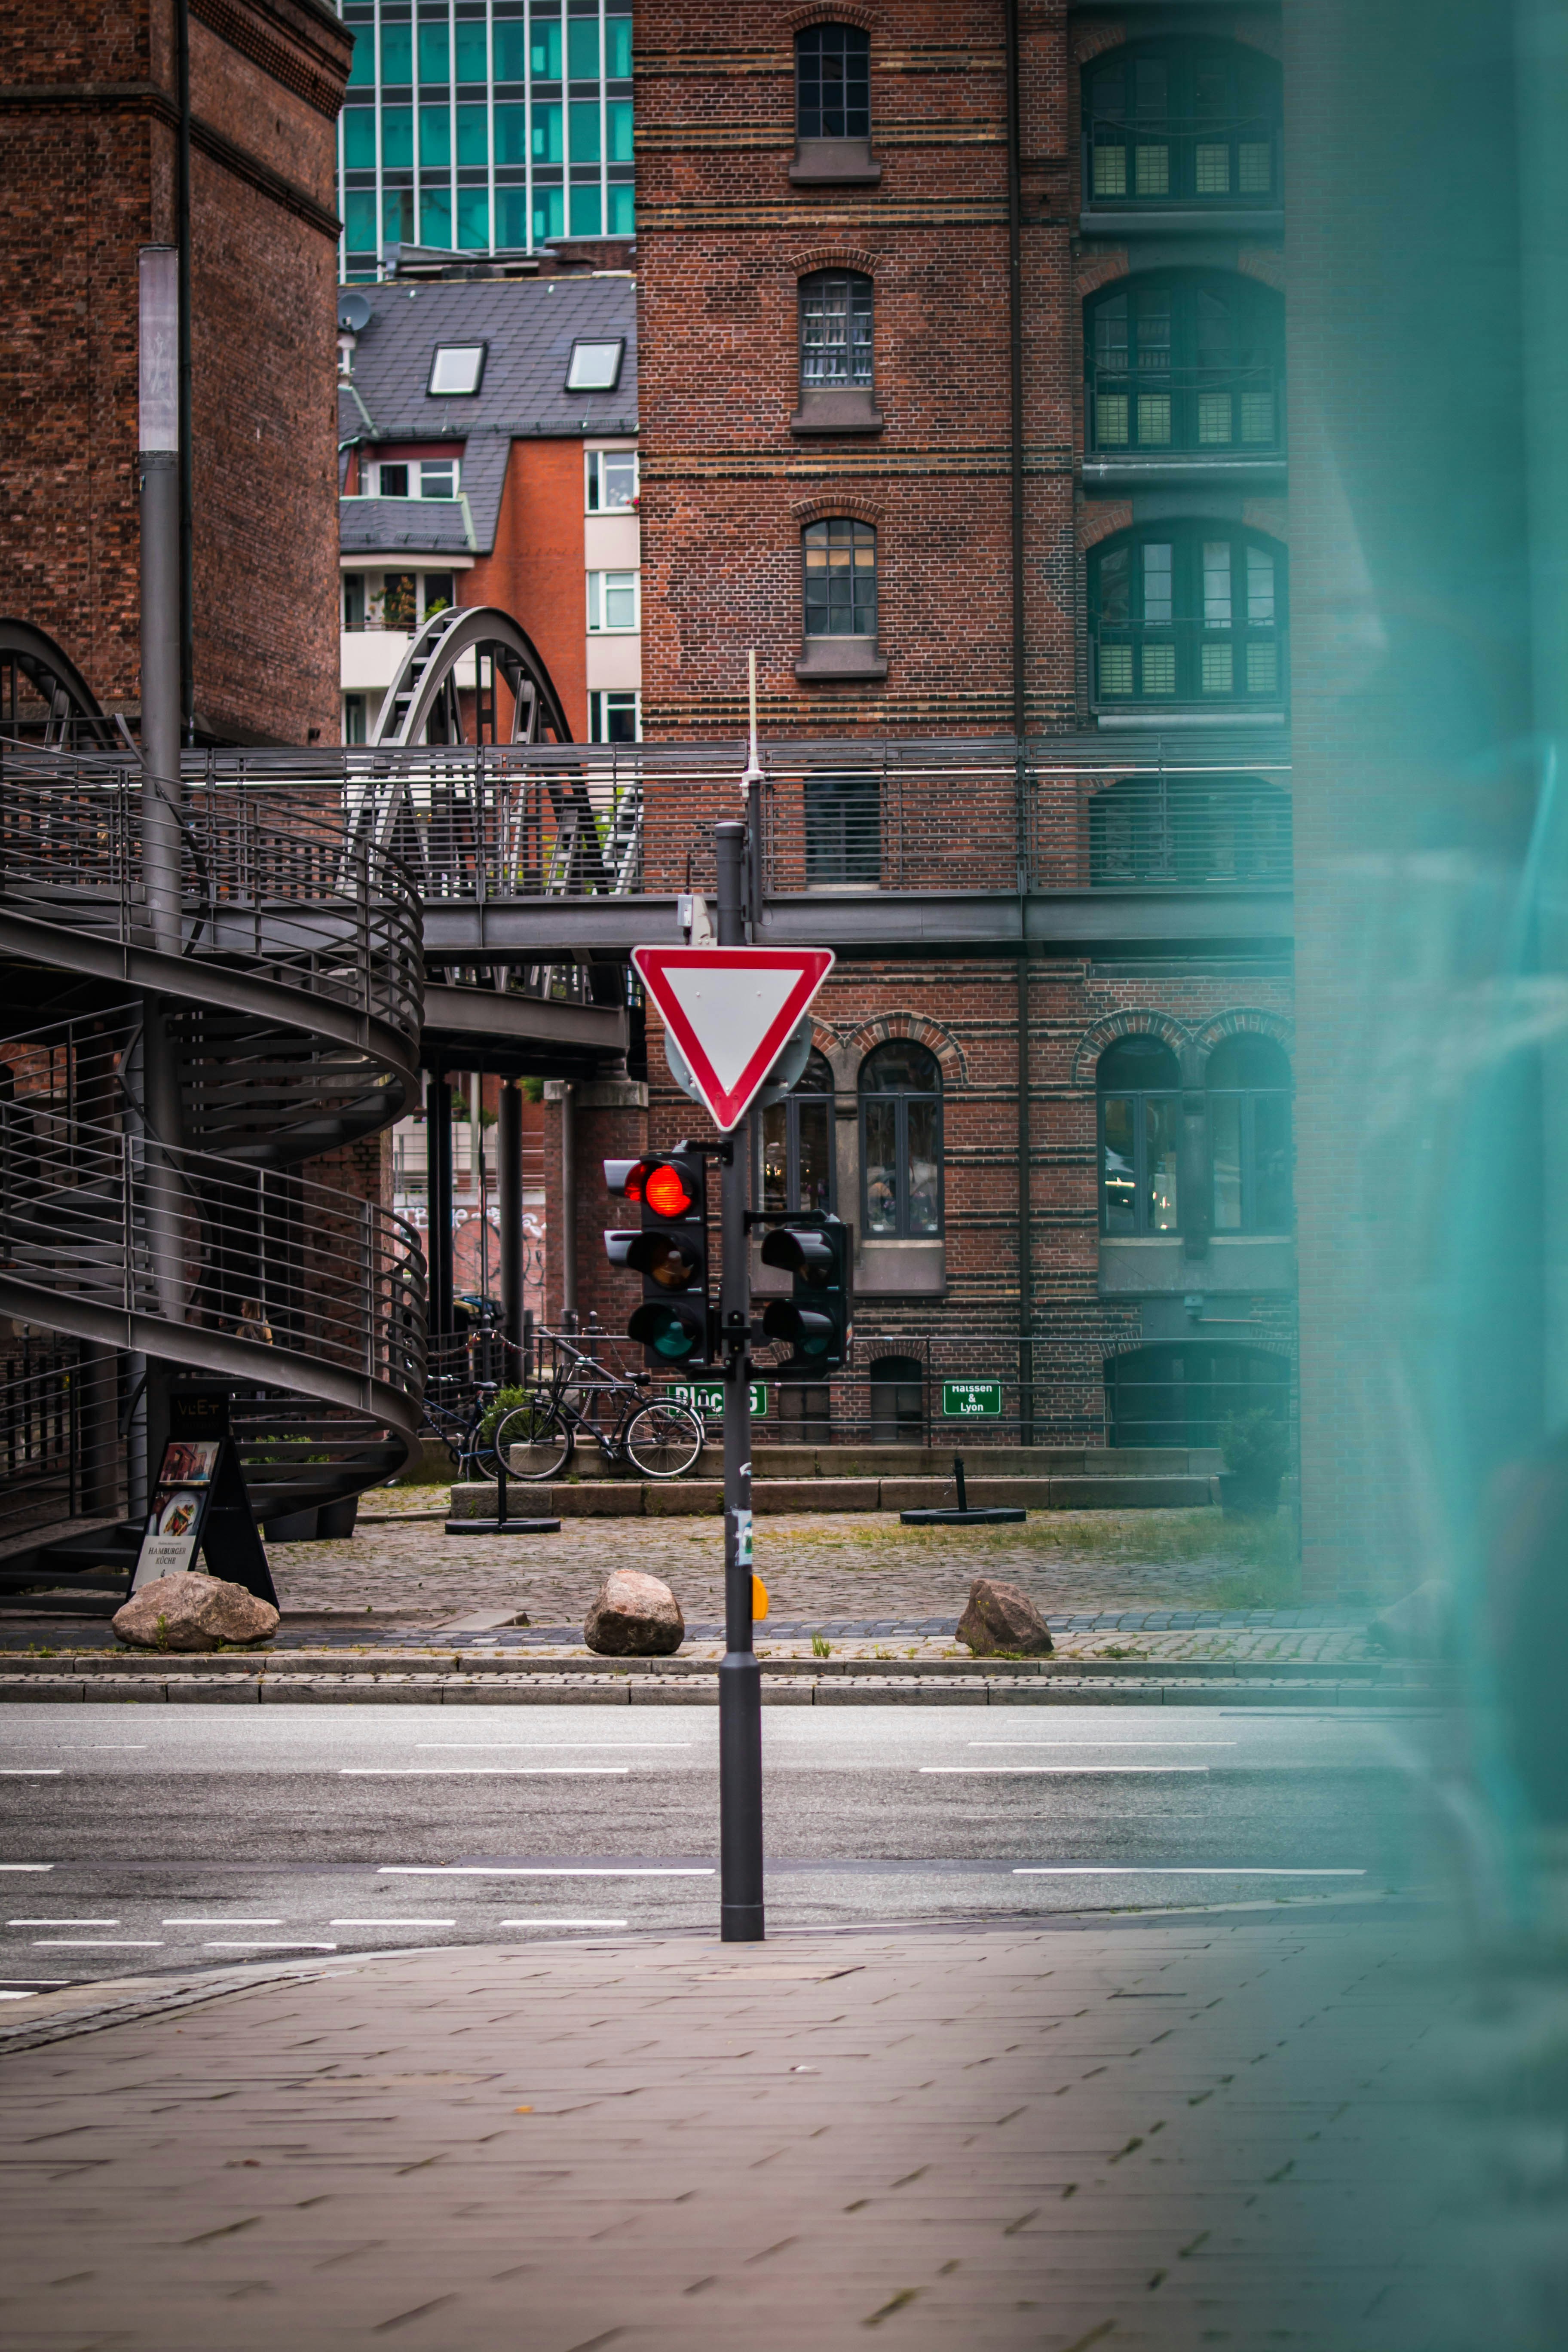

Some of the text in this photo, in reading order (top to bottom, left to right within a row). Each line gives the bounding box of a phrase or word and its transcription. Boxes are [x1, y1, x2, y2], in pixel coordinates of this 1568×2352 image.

[968, 1393, 976, 1403] &
[961, 1403, 983, 1413] Lyon
[155, 1556, 176, 1564] KÜCHE
